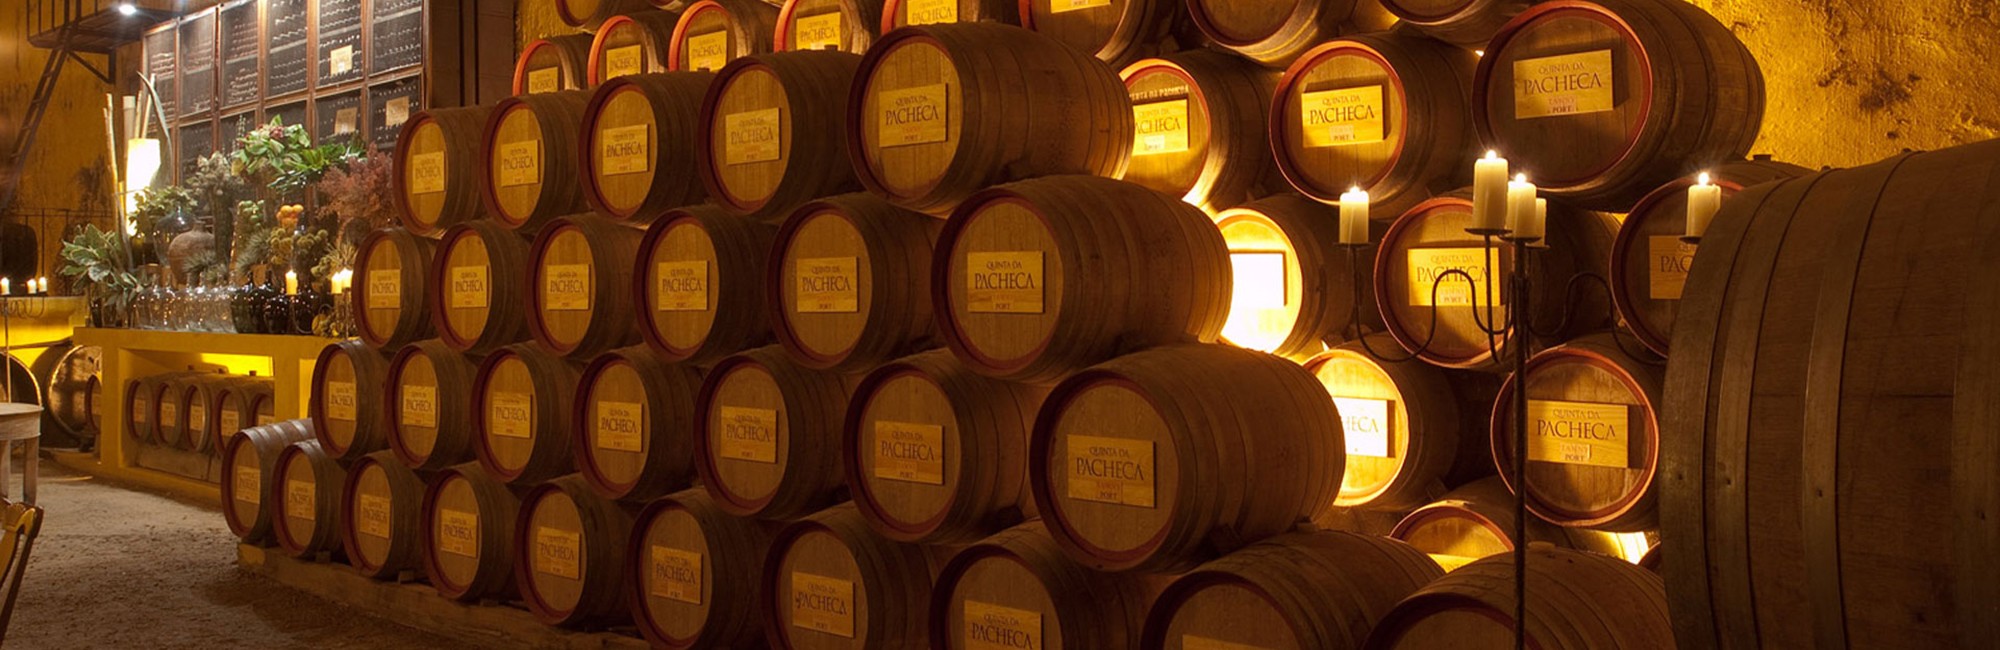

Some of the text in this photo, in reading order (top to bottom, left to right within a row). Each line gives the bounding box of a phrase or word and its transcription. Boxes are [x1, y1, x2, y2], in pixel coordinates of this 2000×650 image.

[911, 6, 953, 23] PACHECA
[1538, 61, 1585, 75] QUINTA DA
[1523, 72, 1602, 95] PACHECA
[1322, 94, 1361, 106] QUINTA DA
[885, 104, 939, 126] PACHECA
[1310, 104, 1375, 125] PACHECA
[1135, 117, 1181, 134] ACHECA
[731, 126, 774, 145] PACHECA
[605, 141, 643, 158] PACHECA
[974, 271, 1035, 290] PACHECA
[1416, 265, 1487, 282] PACHECA
[662, 277, 702, 292] PACHECA
[802, 275, 851, 292] PACHECA
[1552, 408, 1600, 420] QUINTA DA
[601, 417, 637, 434] PACHECA
[726, 423, 770, 442] PACHECA
[1536, 419, 1616, 441] PACHECA
[881, 440, 935, 462] PACHECA
[1565, 453, 1585, 462] PORT
[1076, 457, 1144, 481] PACHECA
[540, 541, 575, 561] PACHECA
[656, 563, 696, 585] PACHECA
[797, 591, 847, 616] PACHECA
[972, 622, 1033, 650] PACHECA
